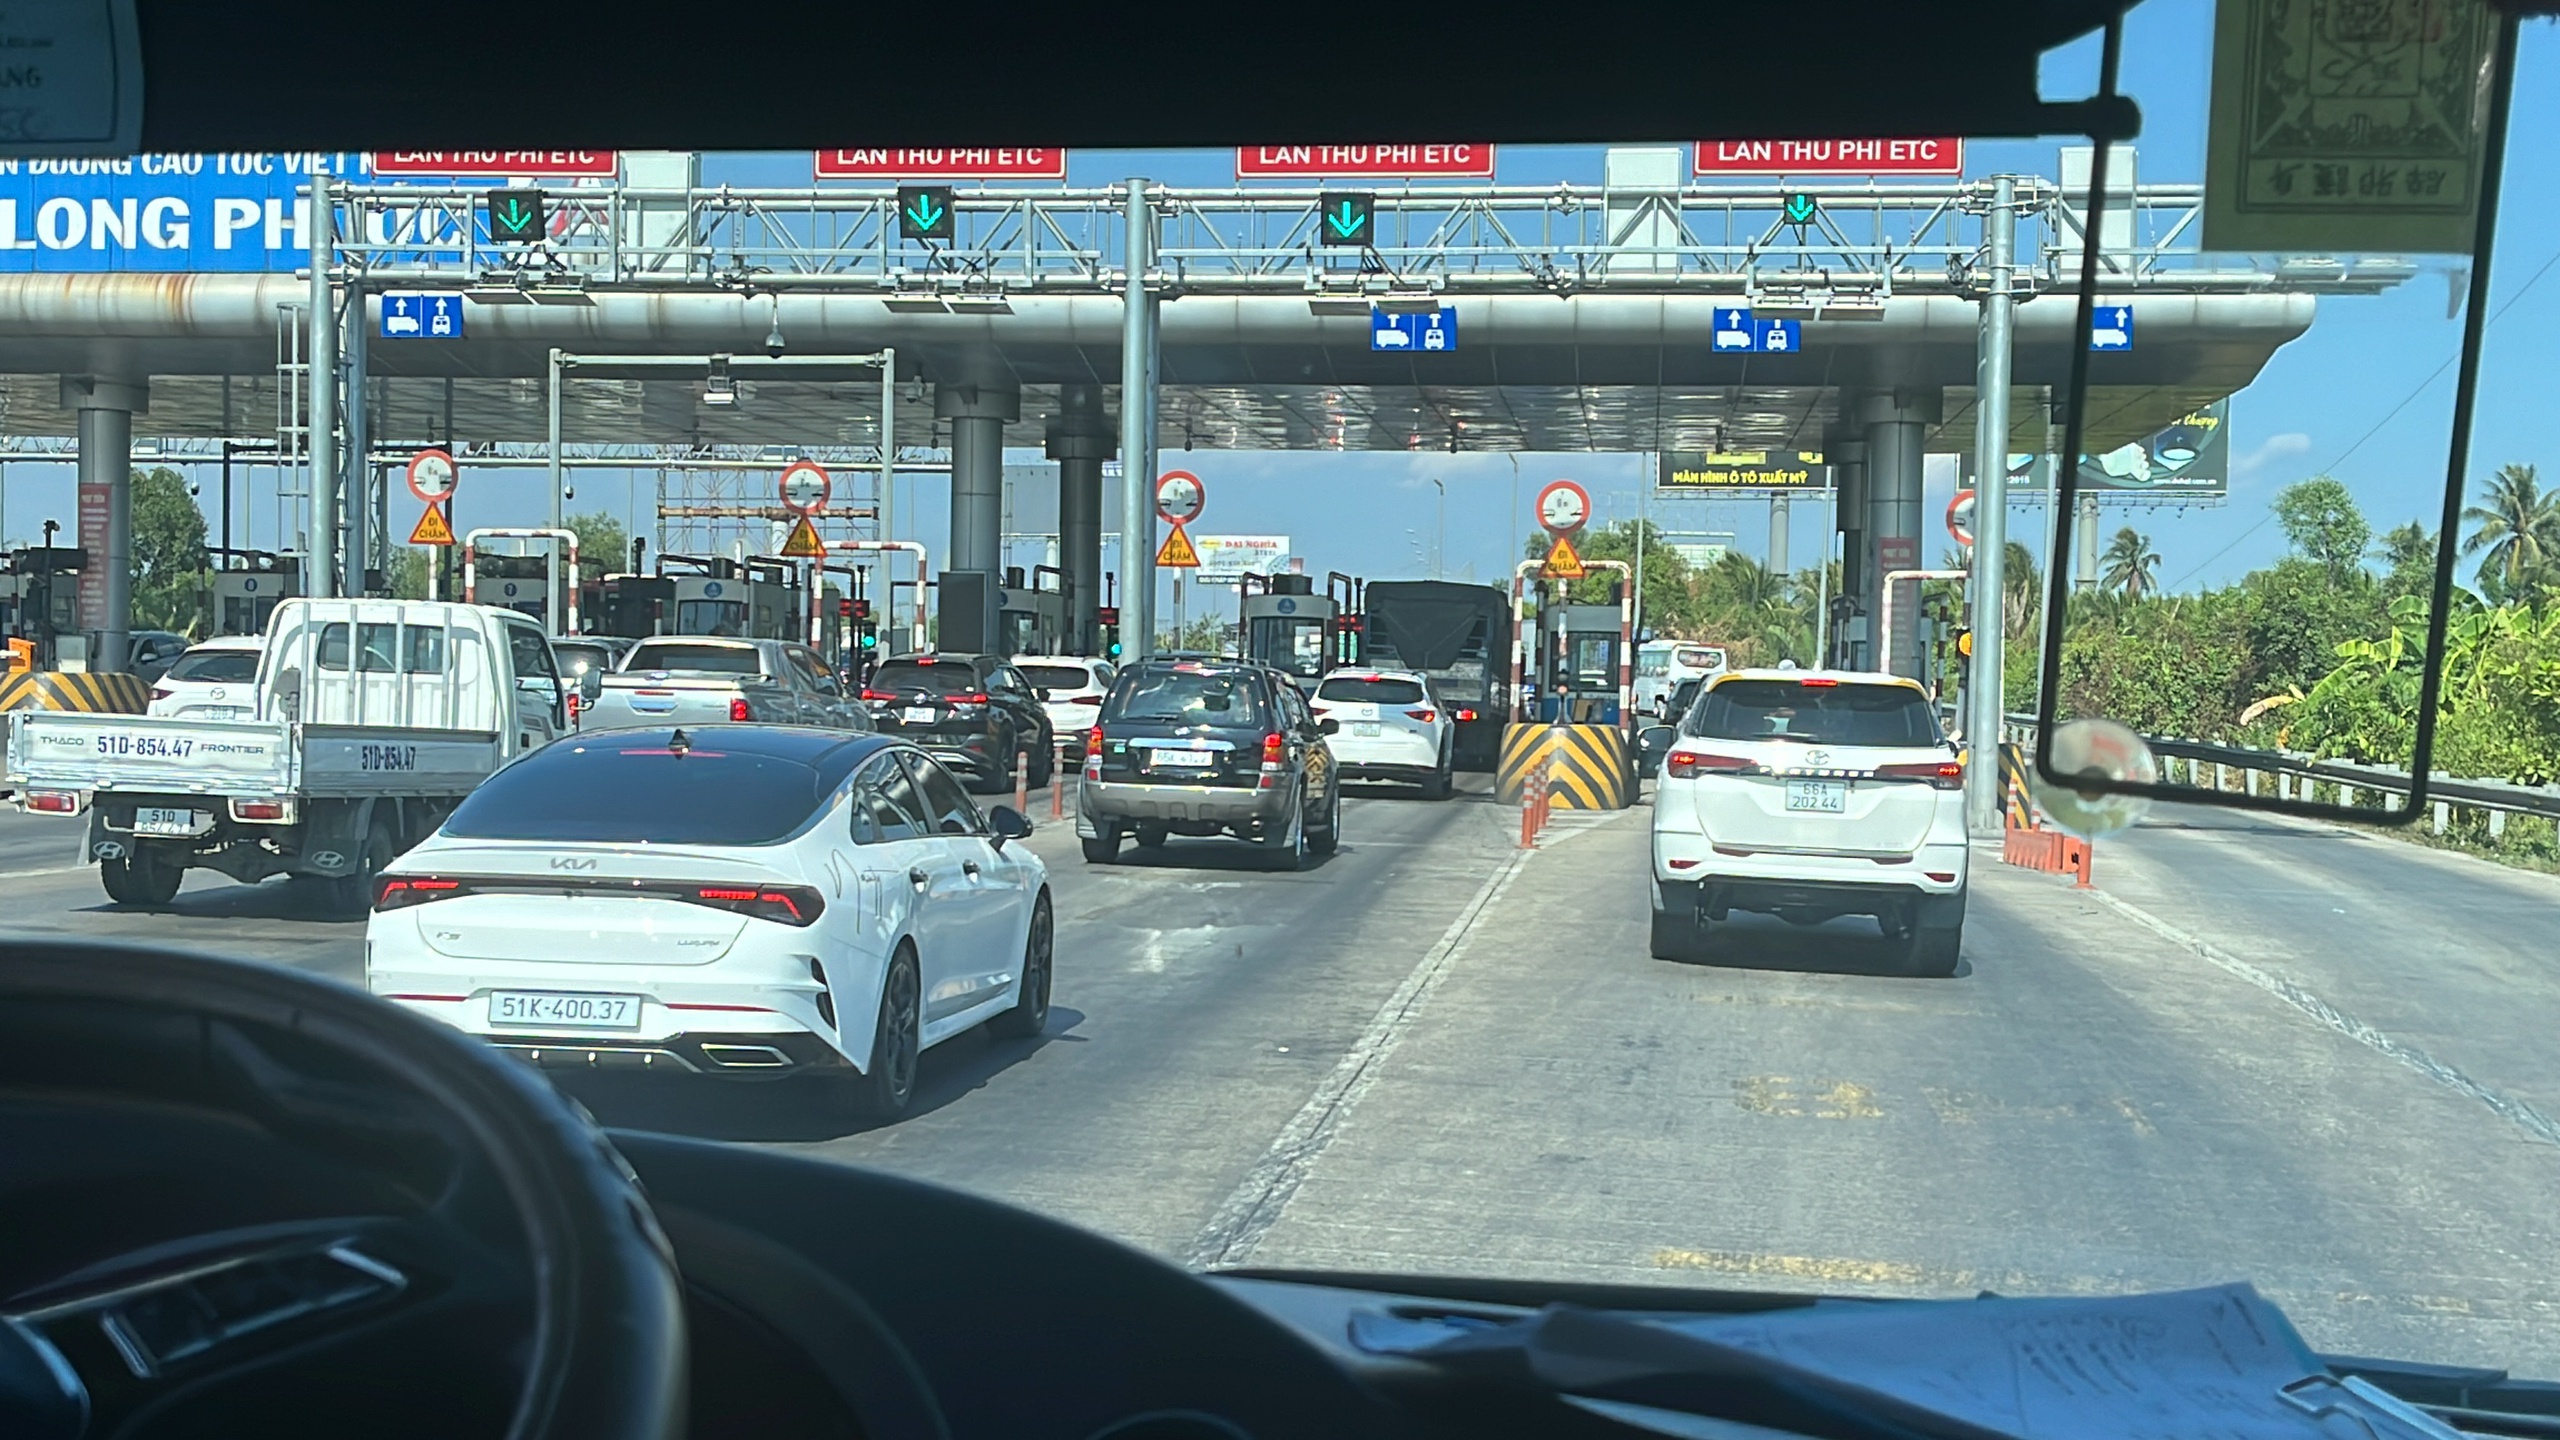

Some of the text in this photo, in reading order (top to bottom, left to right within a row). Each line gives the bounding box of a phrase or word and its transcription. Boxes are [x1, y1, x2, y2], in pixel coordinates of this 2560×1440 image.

[1318, 145, 1367, 165] THU
[1424, 145, 1470, 165] ETC
[1779, 141, 1830, 161] THU
[1890, 141, 1938, 161] ETC
[0, 197, 190, 250] LONG
[41, 736, 264, 758] THACO 51D-854.47 FRONTIER
[362, 745, 416, 770] 51D-854.47
[1803, 783, 1828, 795] 66A
[152, 810, 175, 822] 51D
[551, 857, 597, 870] KIA
[503, 998, 627, 1021] 51K-400.37
